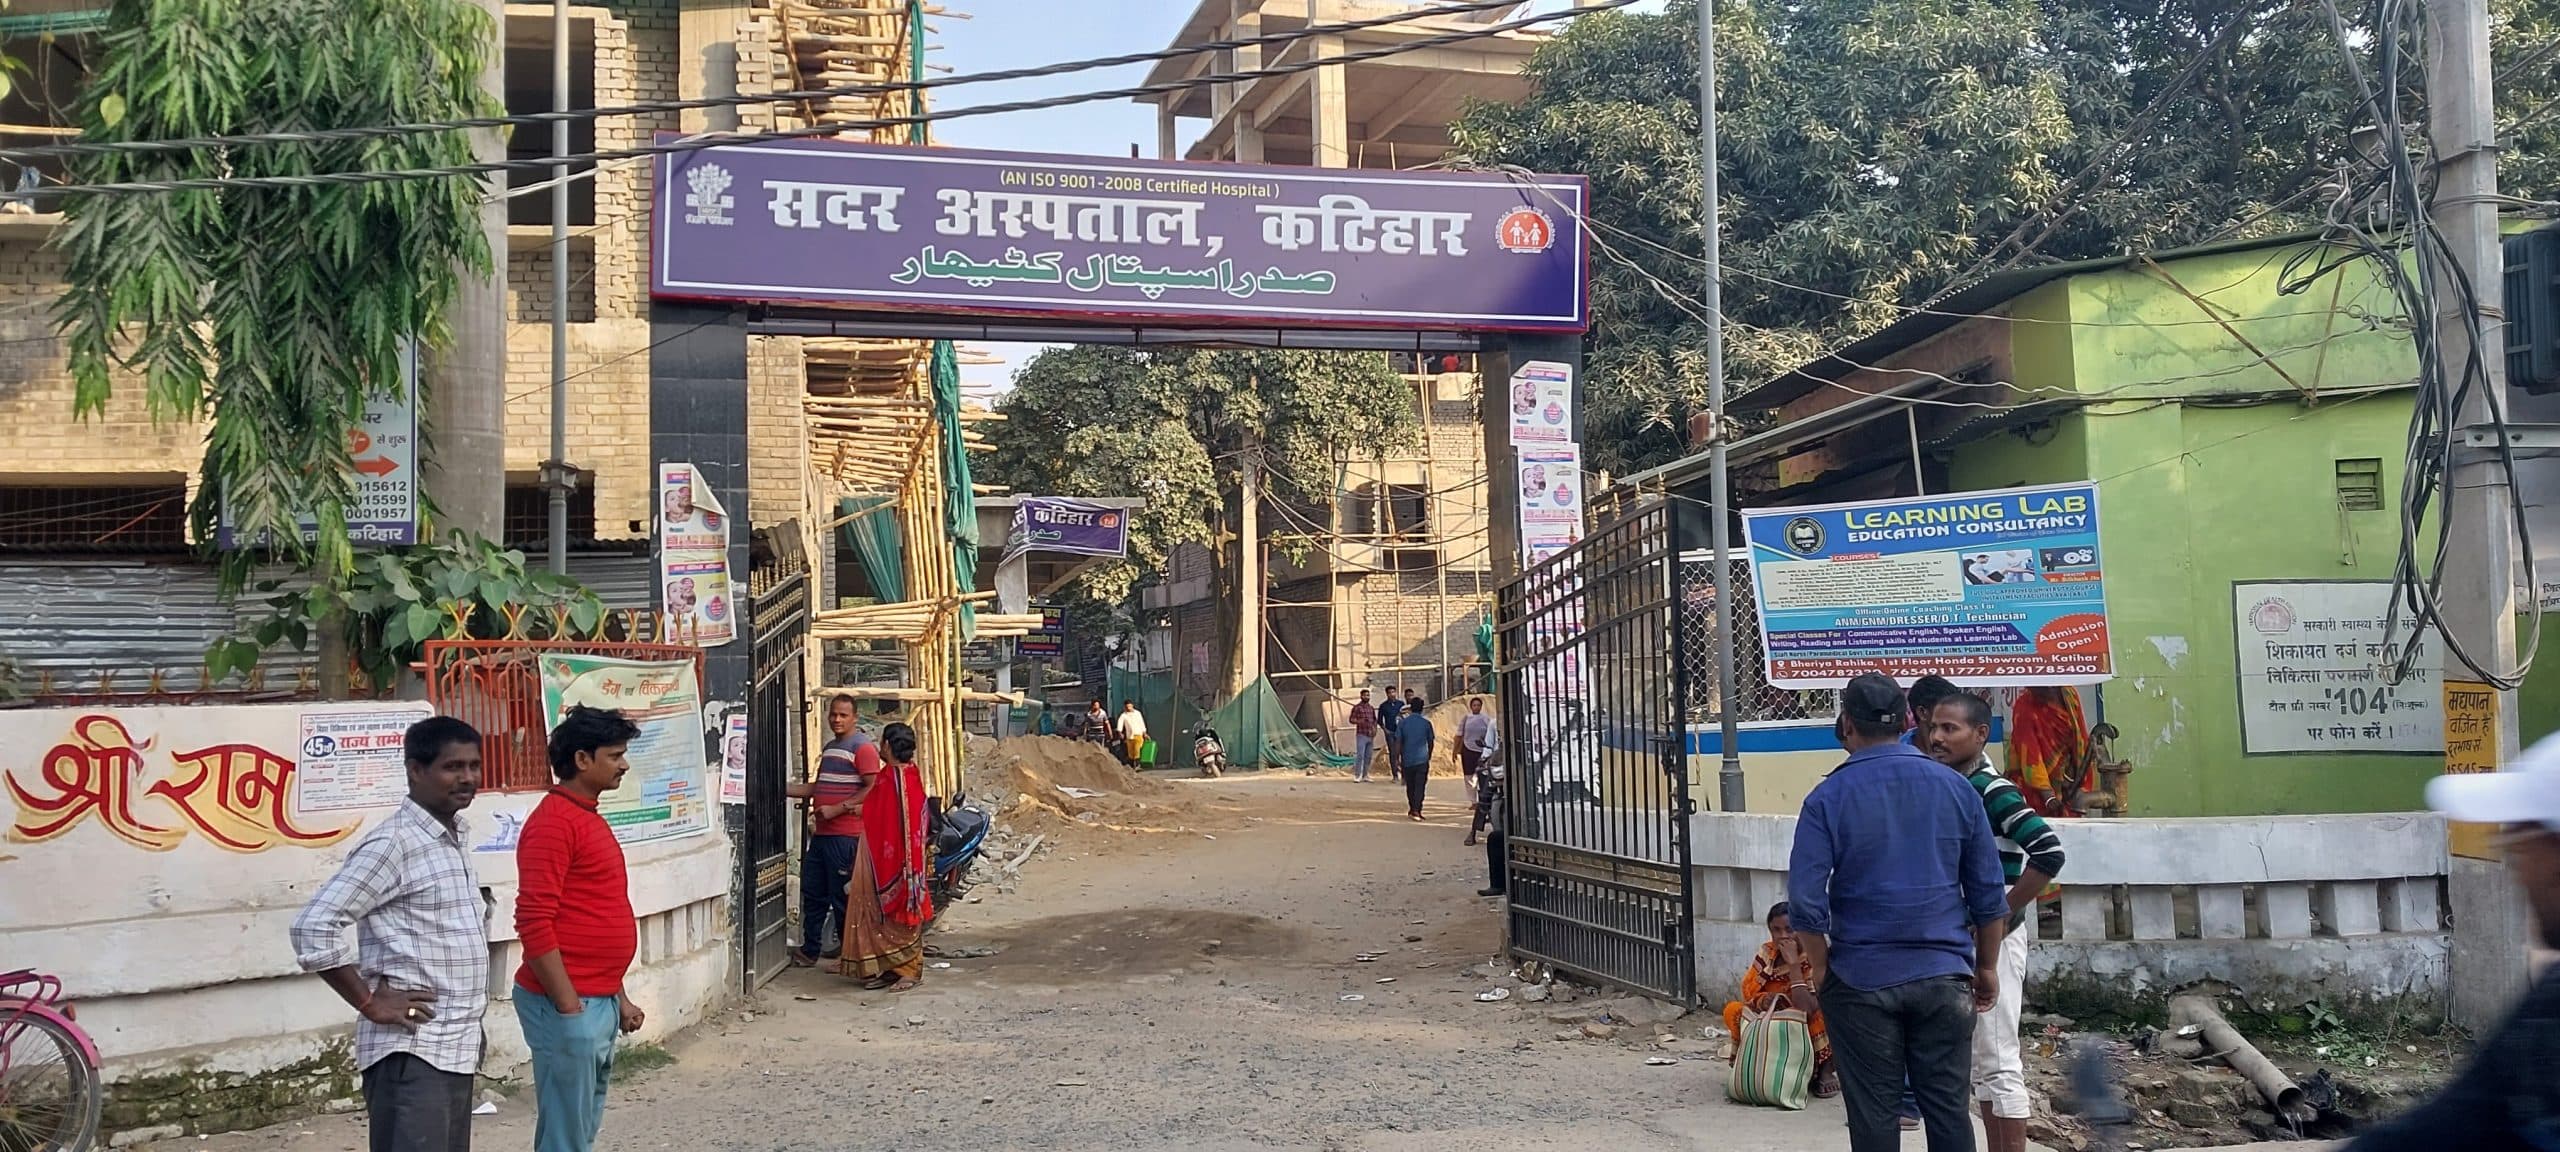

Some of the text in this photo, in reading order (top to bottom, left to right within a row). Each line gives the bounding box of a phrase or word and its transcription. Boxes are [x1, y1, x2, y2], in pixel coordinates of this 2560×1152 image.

[1000, 170, 1027, 186] (AN
[1031, 172, 1055, 188] ISO
[1060, 174, 1142, 191] 9001-2008
[1146, 178, 1207, 195] Certified
[1211, 180, 1271, 198] Hospital
[762, 180, 906, 232] सदर
[935, 188, 1224, 257] अस्पताल,
[1255, 194, 1473, 257] कटिहार
[1034, 505, 1096, 526] कटिहार
[1845, 495, 2087, 530] LEARNING LAB
[1848, 524, 1950, 543] EDUCATION
[1956, 513, 2088, 534] CONSULTANCY
[1834, 553, 1877, 562] COURSES
[1966, 612, 2027, 622] Technician
[2302, 617, 2337, 632] सरकारी
[1769, 632, 1797, 640] Special
[1848, 629, 1908, 638] Communicative
[1943, 627, 1974, 636] Spoken
[1976, 625, 2008, 634] English
[1801, 640, 1831, 648] Reading
[1848, 637, 1884, 647] Listening
[1886, 636, 1907, 644] skills
[1917, 634, 1952, 643] students
[1963, 634, 2000, 644] Learning
[2002, 633, 2018, 641] Lab
[2038, 620, 2105, 643] Admission
[2056, 637, 2092, 650] Open
[2265, 639, 2327, 660] शिकायत
[2334, 637, 2358, 659] दर्ज
[1882, 658, 1898, 666] 1st
[1902, 657, 1932, 665] Floor
[1935, 656, 1974, 665] Honda
[1978, 655, 2047, 664] Showroom,
[2051, 653, 2098, 663] Katihar
[1996, 664, 2097, 674] 6201785400
[2266, 665, 2321, 684] चिकित्सा
[2268, 700, 2287, 712] टोल
[2448, 691, 2493, 712] मद्यपान
[2307, 727, 2324, 740] पर
[2329, 723, 2356, 740] फोन
[2362, 722, 2383, 740] करें
[2449, 712, 2480, 734] वर्जित
[5, 714, 342, 848] श्री राम
